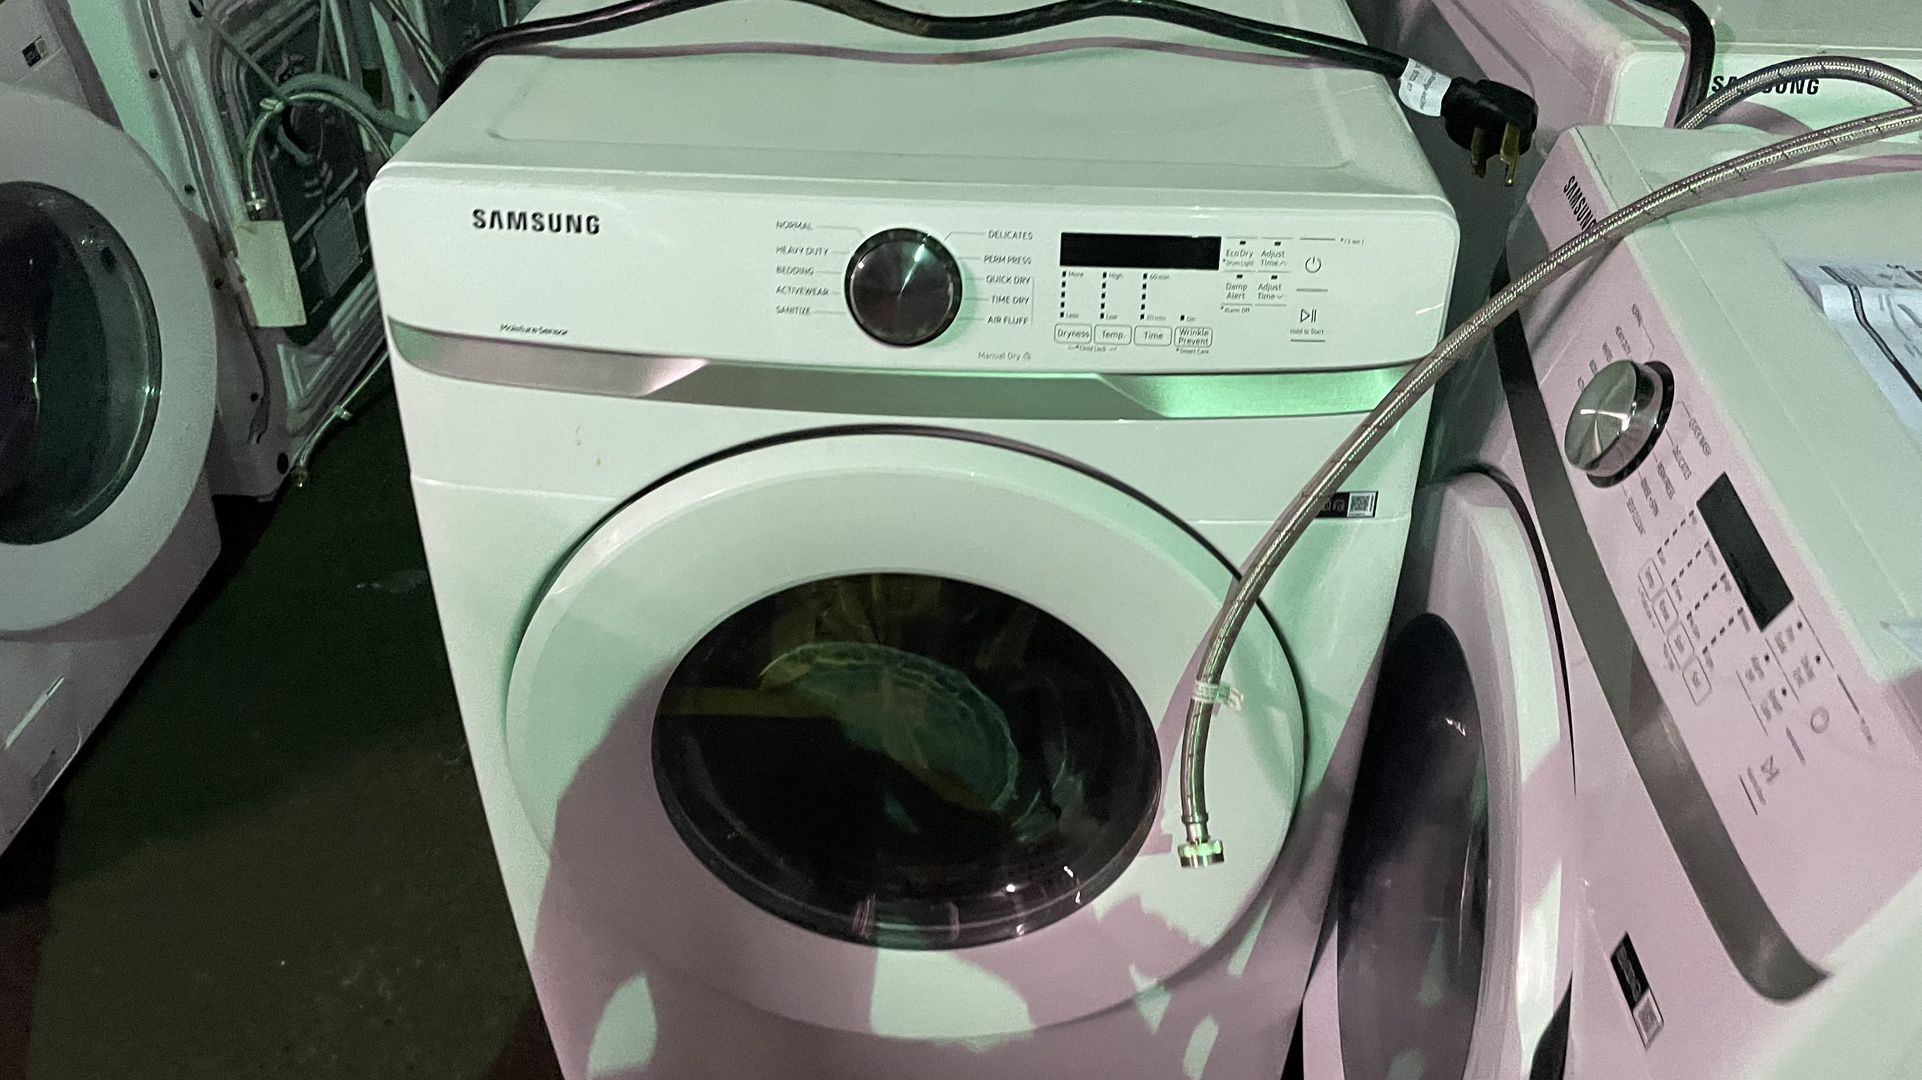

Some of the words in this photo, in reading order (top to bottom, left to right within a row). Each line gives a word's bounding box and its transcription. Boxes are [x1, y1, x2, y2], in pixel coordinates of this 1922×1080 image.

[1711, 75, 1819, 94] SUNG
[472, 208, 600, 235] SAMSUNG
[776, 220, 812, 231] NORMAL
[988, 229, 1033, 240] DELICATES
[776, 245, 804, 255] HEAVY
[805, 247, 829, 256] DUTY
[1261, 250, 1285, 259] Adjust
[983, 254, 1006, 264] PERM
[1007, 255, 1033, 265] PRESS
[776, 265, 815, 276] BEDDING
[986, 274, 1012, 285] QUICK
[1013, 275, 1031, 285] DRY
[776, 285, 829, 296] ACTIVEWEAR
[1226, 282, 1248, 292] Damp
[1258, 282, 1282, 292] Adjust
[992, 294, 1011, 305] TIME
[1012, 295, 1030, 305] DRY
[1226, 291, 1245, 300] Alert
[1257, 292, 1275, 300] Time
[776, 305, 811, 316] SANITIZE
[988, 315, 1002, 325] AIR
[1003, 315, 1029, 326] FLUFF
[1057, 328, 1090, 340] Dryness
[1144, 331, 1164, 340] Time
[1180, 327, 1210, 337] Wrinkle
[1178, 336, 1209, 346] Prevent
